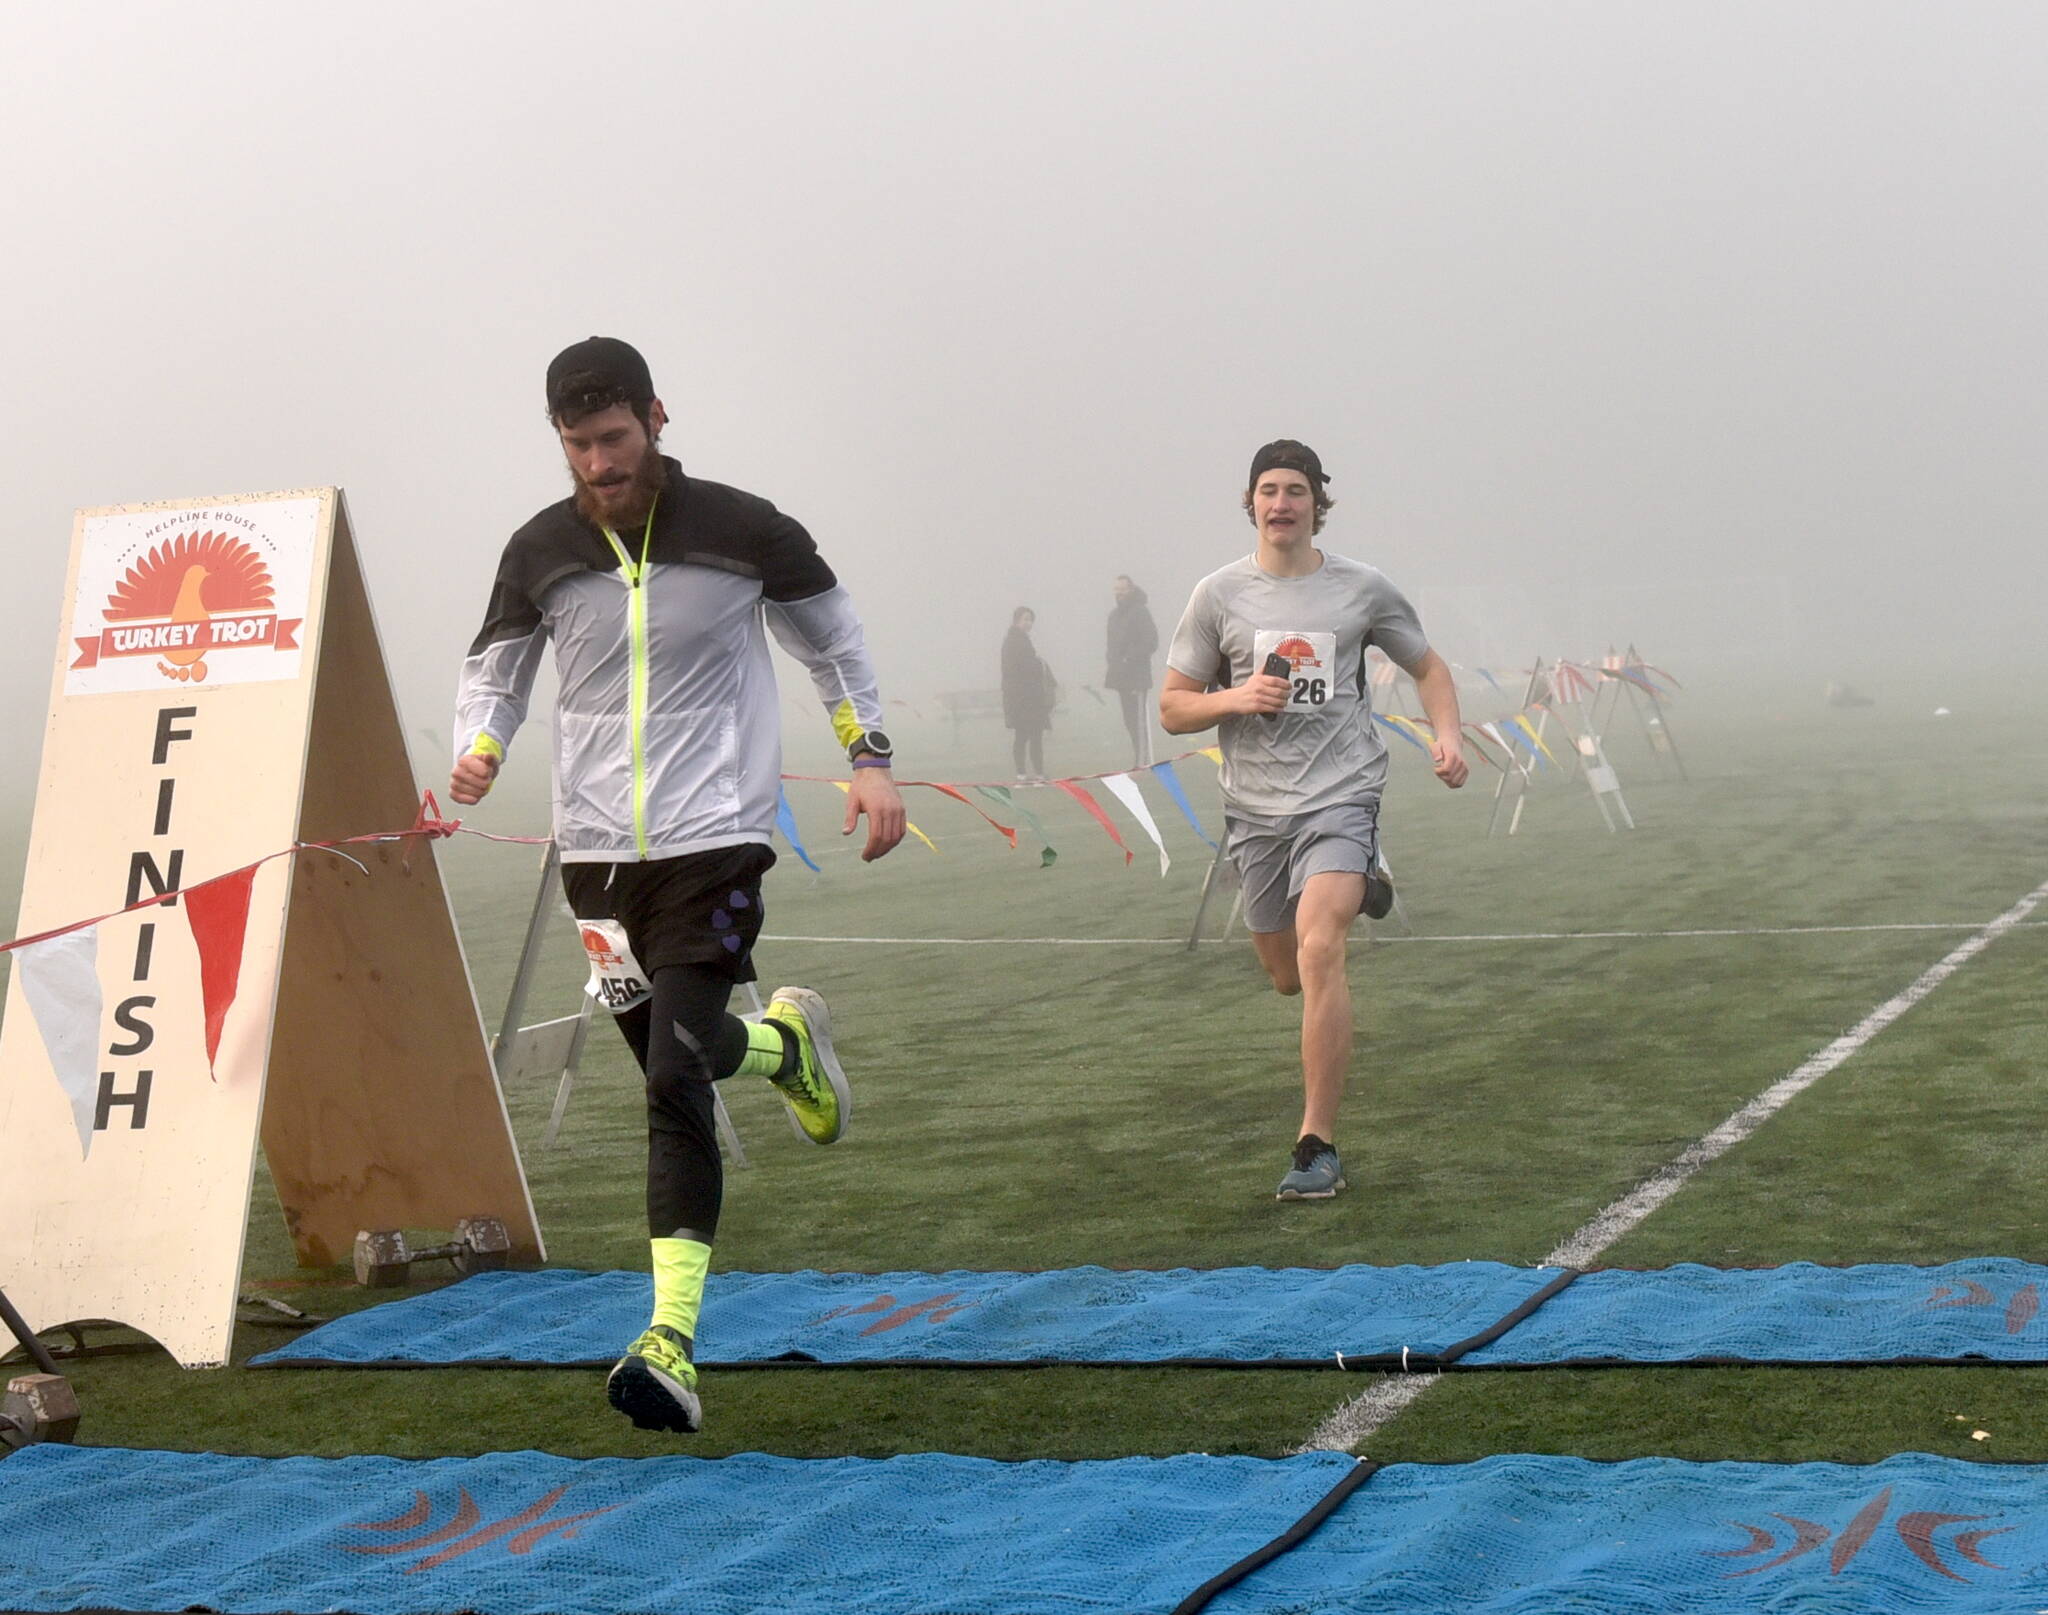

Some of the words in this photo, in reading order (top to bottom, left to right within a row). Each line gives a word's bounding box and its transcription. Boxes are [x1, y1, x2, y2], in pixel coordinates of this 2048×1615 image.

[145, 511, 209, 540] HELPLINE
[214, 511, 257, 533] HOUSE
[111, 622, 200, 652] TURKEY
[209, 617, 271, 644] TROT
[93, 706, 198, 1131] FINISH
